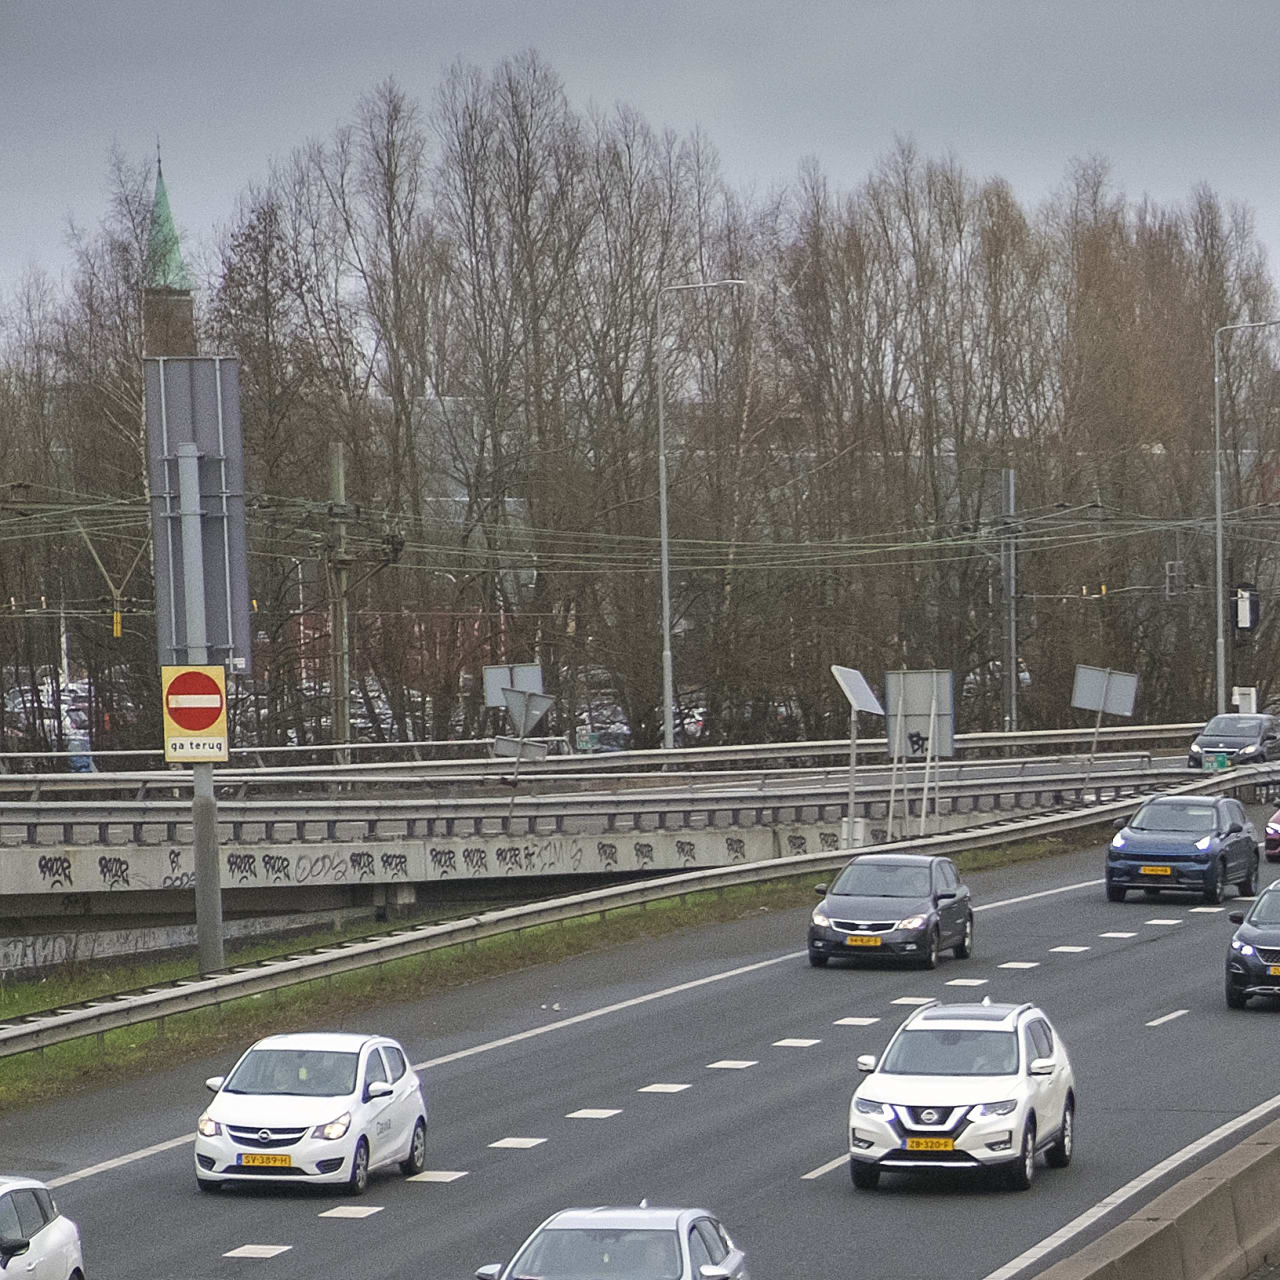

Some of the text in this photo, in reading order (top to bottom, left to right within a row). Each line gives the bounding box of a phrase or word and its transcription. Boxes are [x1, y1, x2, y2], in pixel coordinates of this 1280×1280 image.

[171, 741, 222, 752] ga terug
[243, 1155, 288, 1165] SV-389-H
